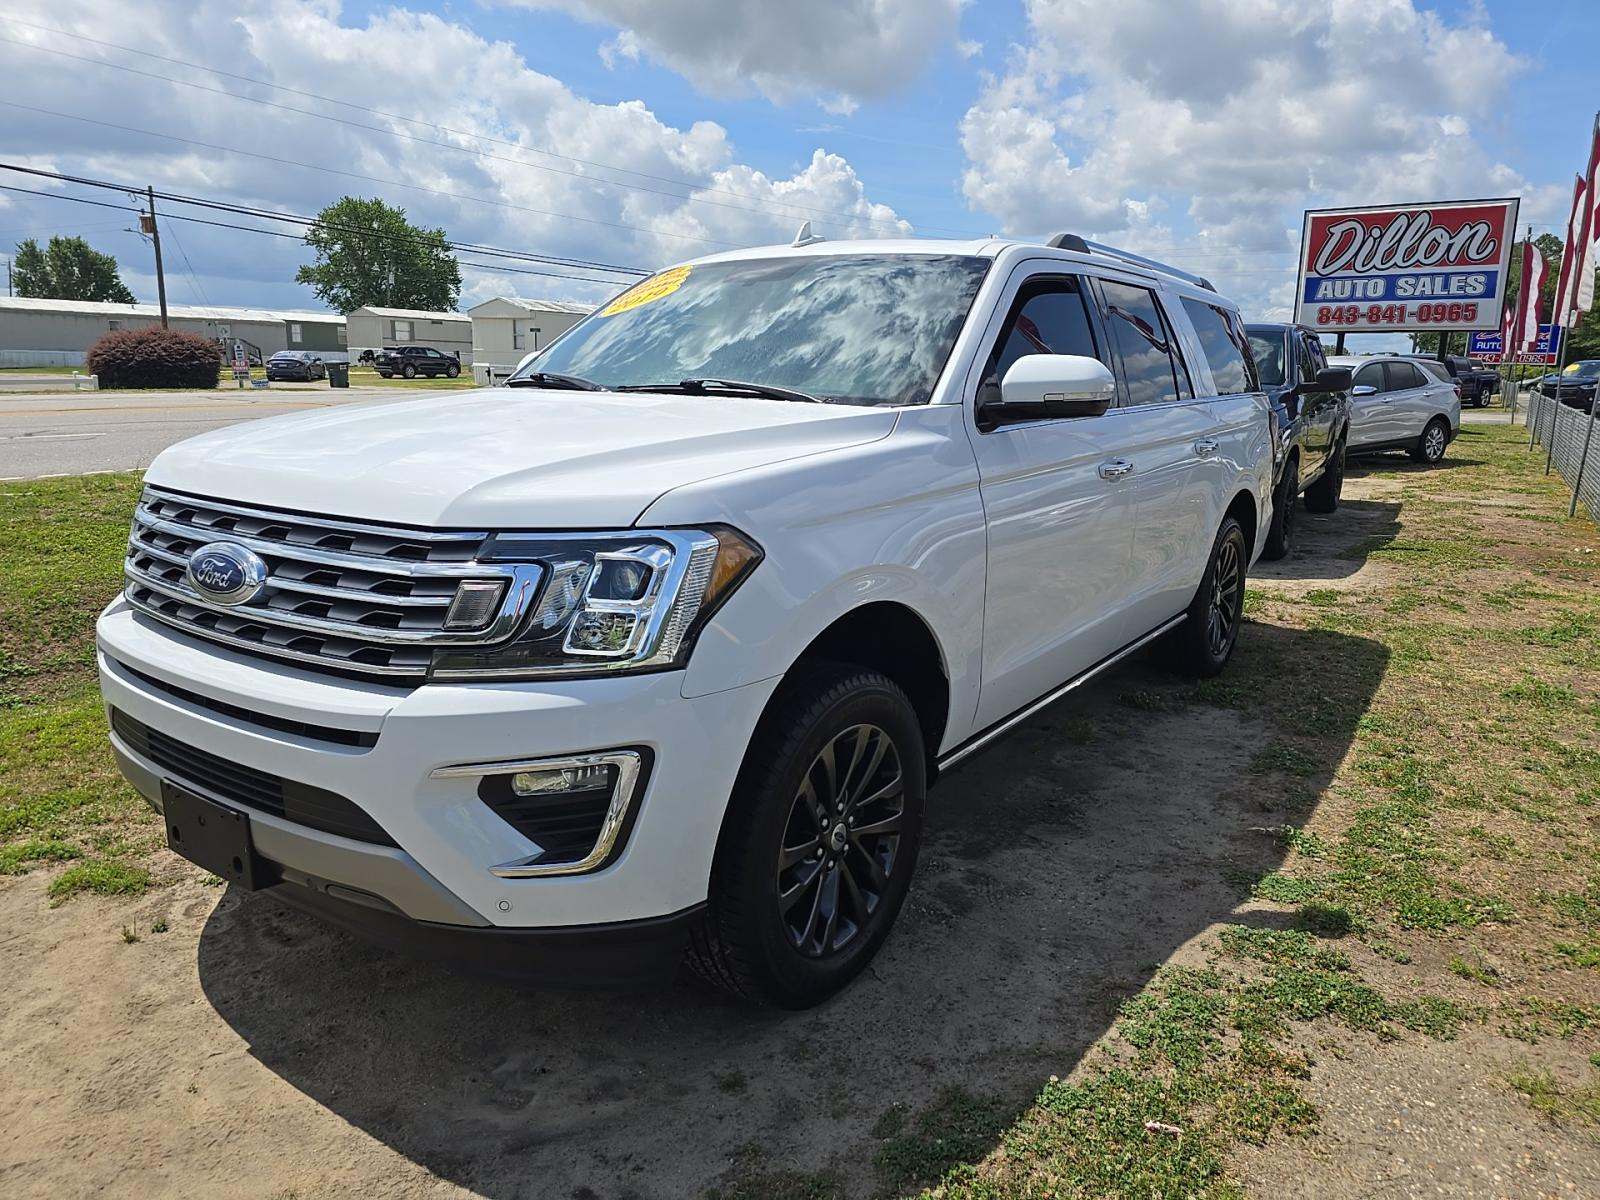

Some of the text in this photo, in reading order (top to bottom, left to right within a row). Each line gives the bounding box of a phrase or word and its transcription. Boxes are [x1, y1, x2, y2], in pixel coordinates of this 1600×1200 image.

[1314, 210, 1496, 276] Dillon
[1316, 274, 1487, 300] AUTO SALES
[1317, 303, 1478, 325] 843-841-0965
[198, 558, 233, 587] Ford
